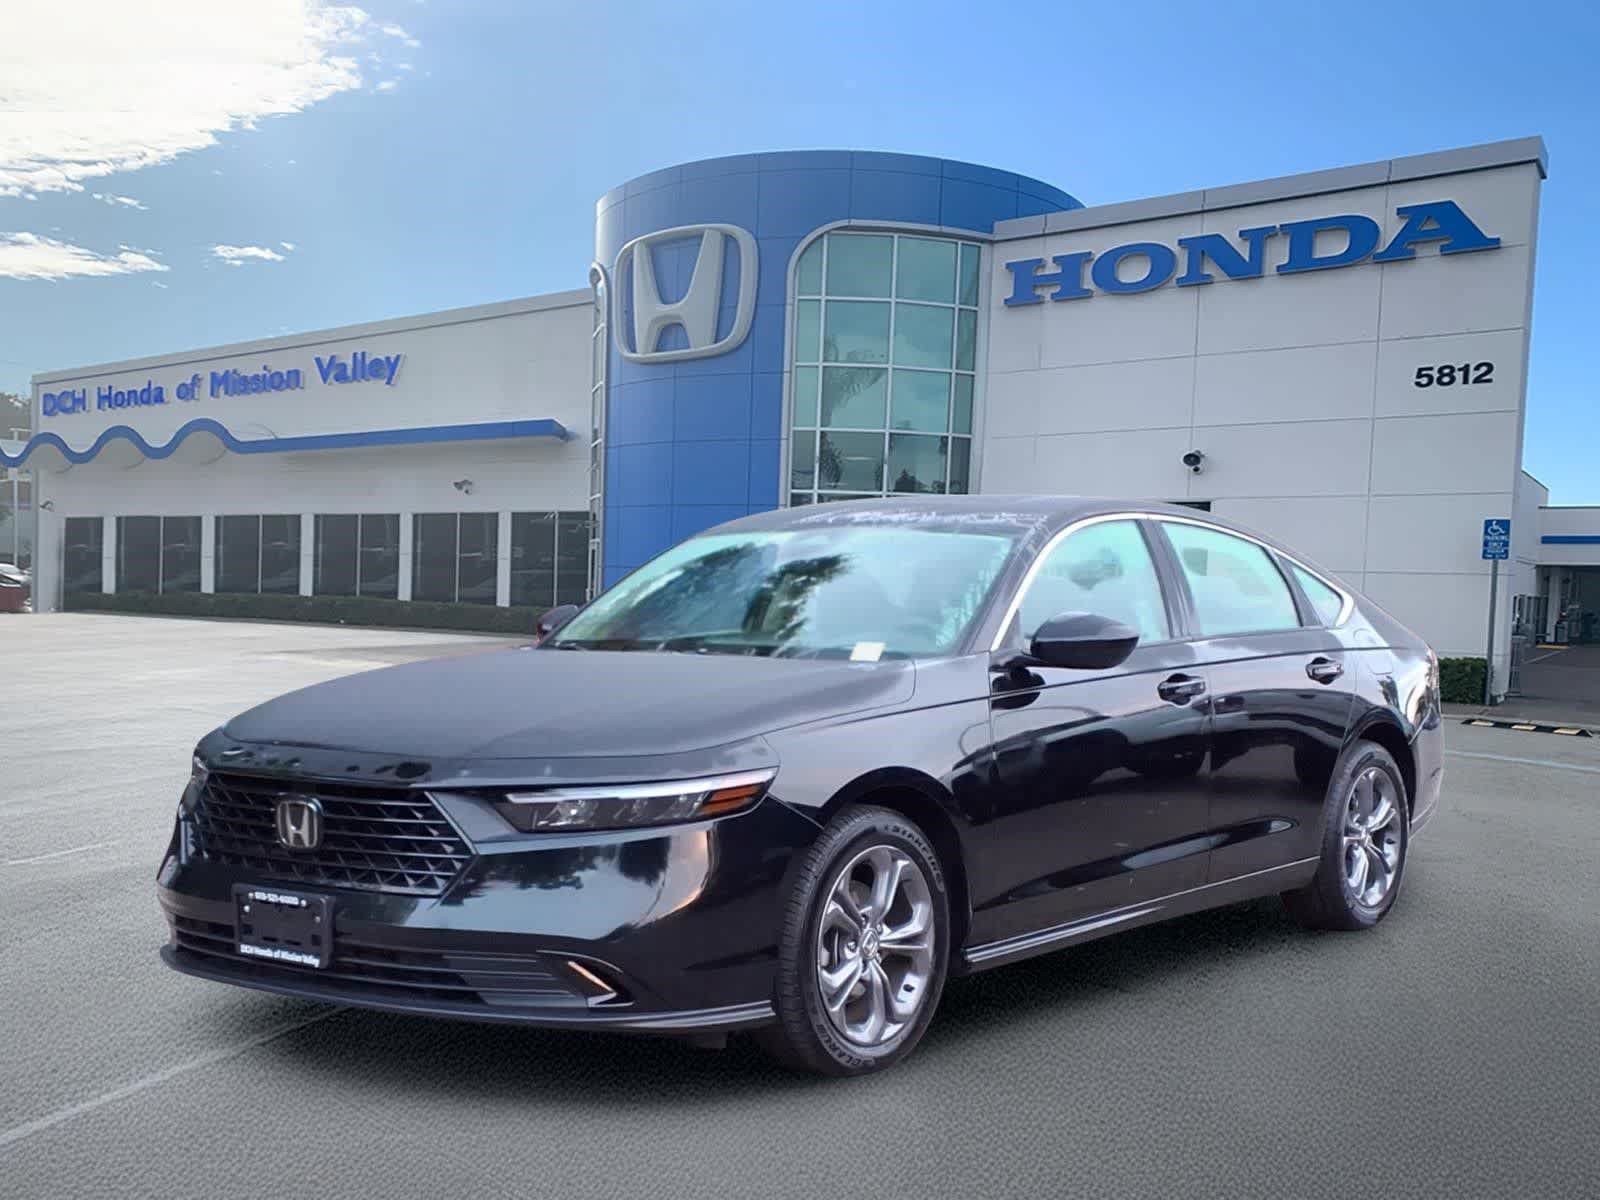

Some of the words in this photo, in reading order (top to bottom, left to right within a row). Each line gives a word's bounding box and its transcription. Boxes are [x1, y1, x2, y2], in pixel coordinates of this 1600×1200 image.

[1003, 199, 1501, 307] HONDA
[42, 388, 88, 417] DCH
[97, 379, 166, 412] Honda
[175, 373, 202, 402] of
[209, 364, 303, 399] Mission
[314, 351, 402, 386] Valley
[1414, 361, 1494, 389] 5812
